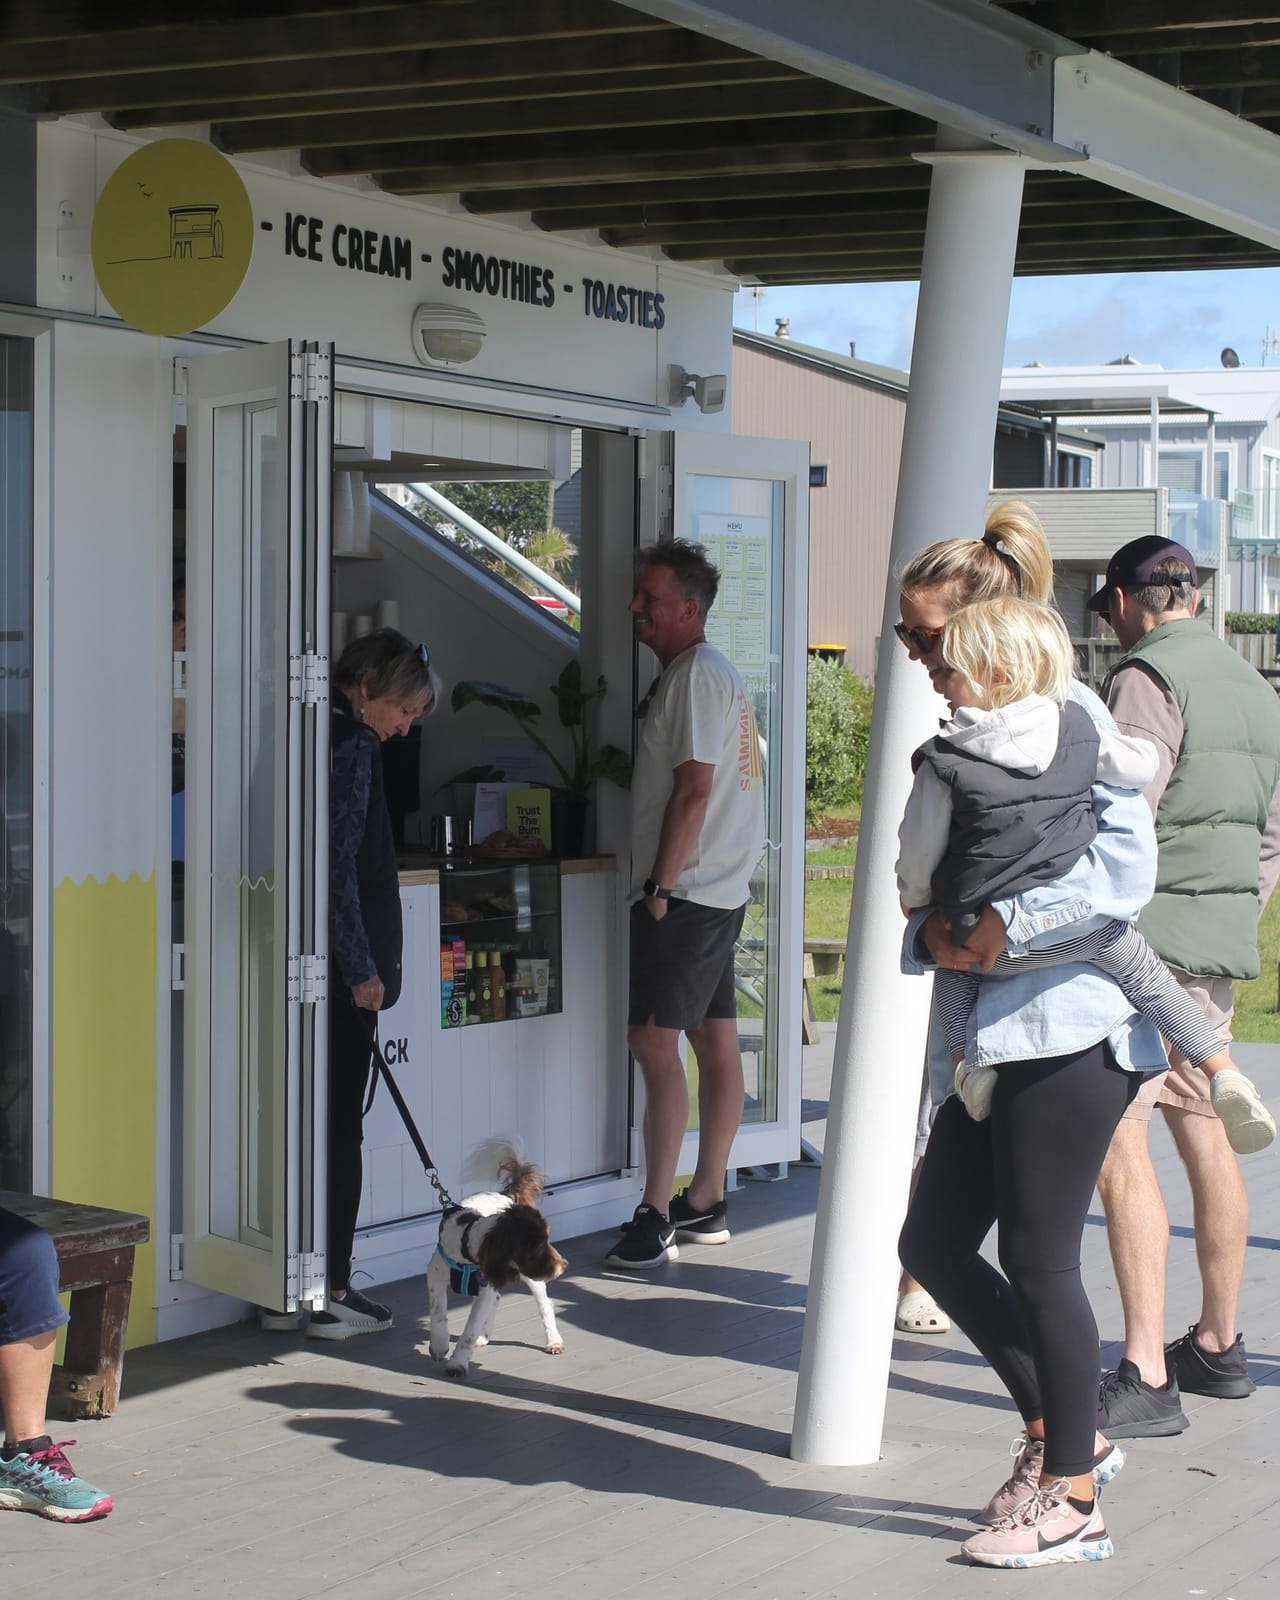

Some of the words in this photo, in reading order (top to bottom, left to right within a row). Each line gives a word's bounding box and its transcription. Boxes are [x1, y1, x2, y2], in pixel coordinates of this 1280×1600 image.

[285, 211, 323, 262] ICE
[332, 223, 412, 280] CREAM
[442, 246, 555, 308] SMOOTHIES
[582, 277, 665, 330] TOASTIES
[727, 522, 743, 530] MENU
[747, 681, 777, 695] SHACK
[515, 805, 541, 816] Trust
[519, 815, 538, 826] The
[518, 825, 541, 835] Bum
